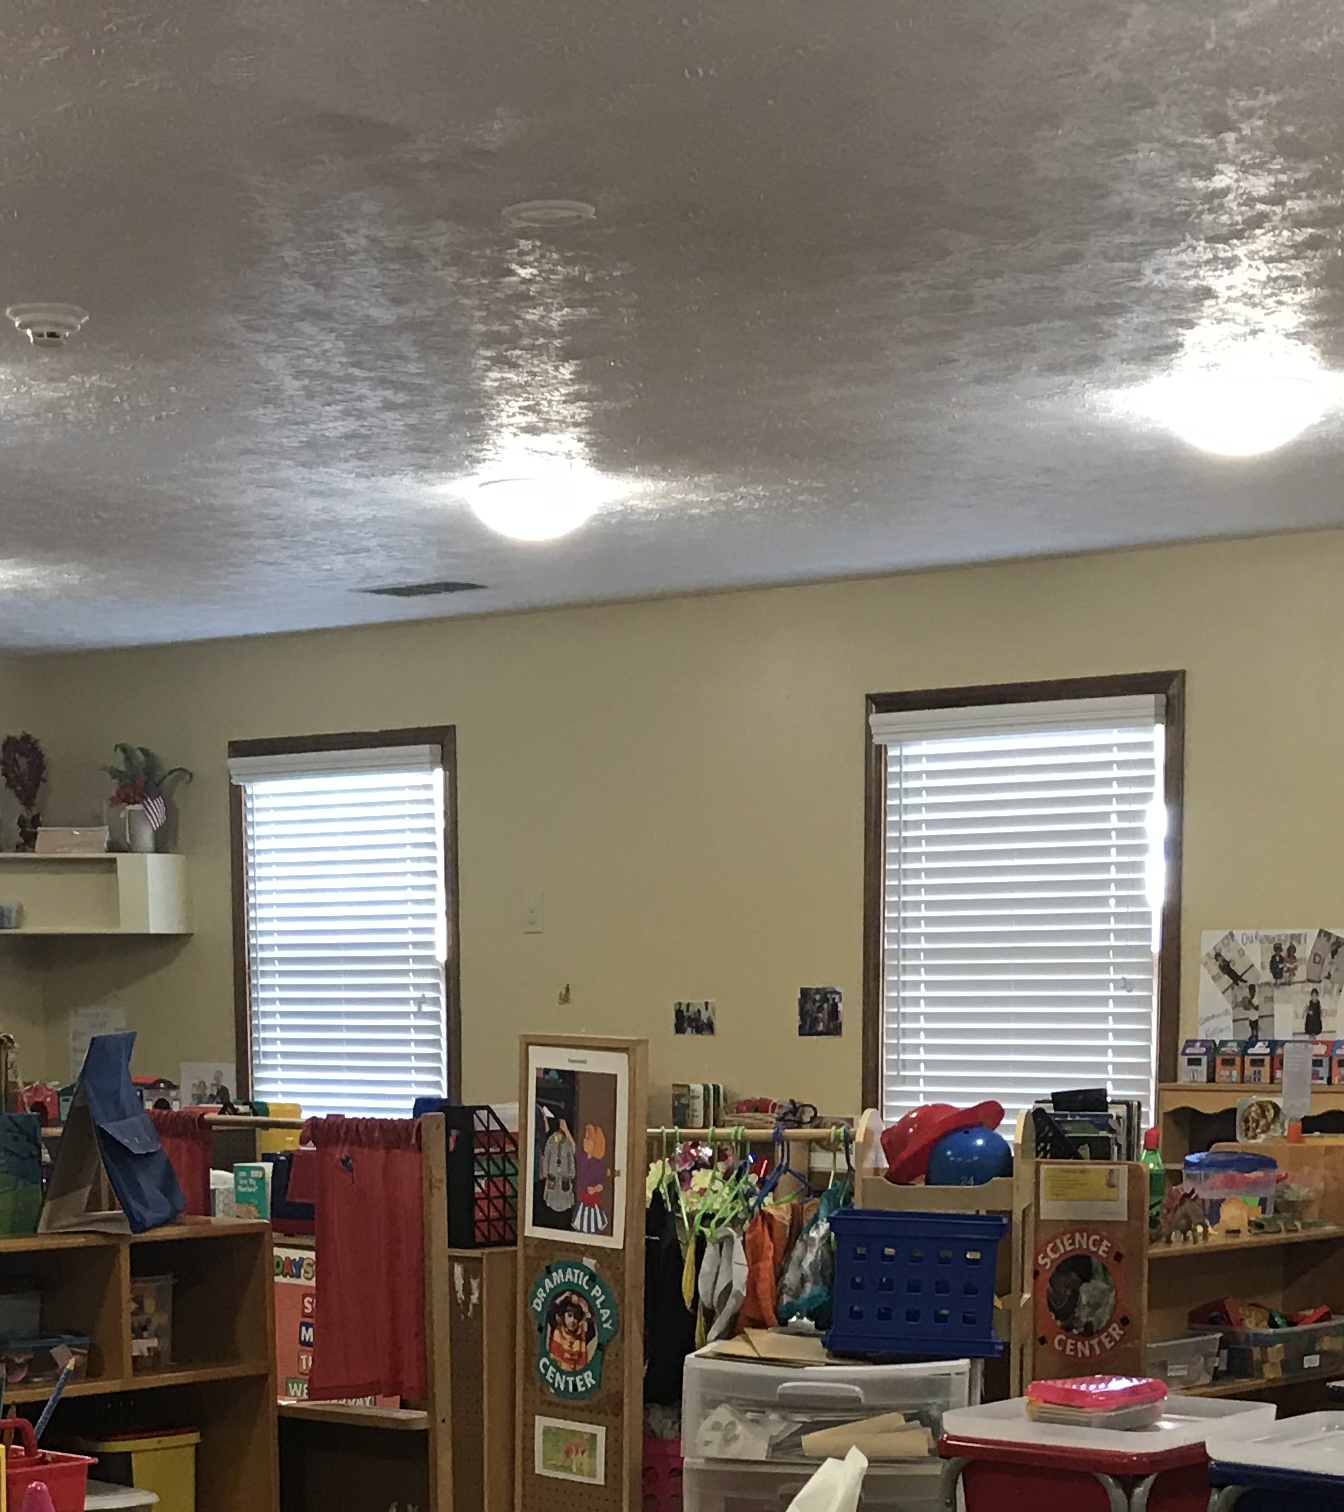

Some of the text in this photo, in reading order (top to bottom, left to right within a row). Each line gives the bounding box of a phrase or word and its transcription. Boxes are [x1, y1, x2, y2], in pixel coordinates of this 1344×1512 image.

[273, 1255, 316, 1282] DAYS
[1037, 1231, 1112, 1270] SCIENCE
[531, 1267, 614, 1331] DRAMATIC PLAY
[1053, 1322, 1125, 1358] CENTER
[539, 1357, 596, 1393] CENTER
